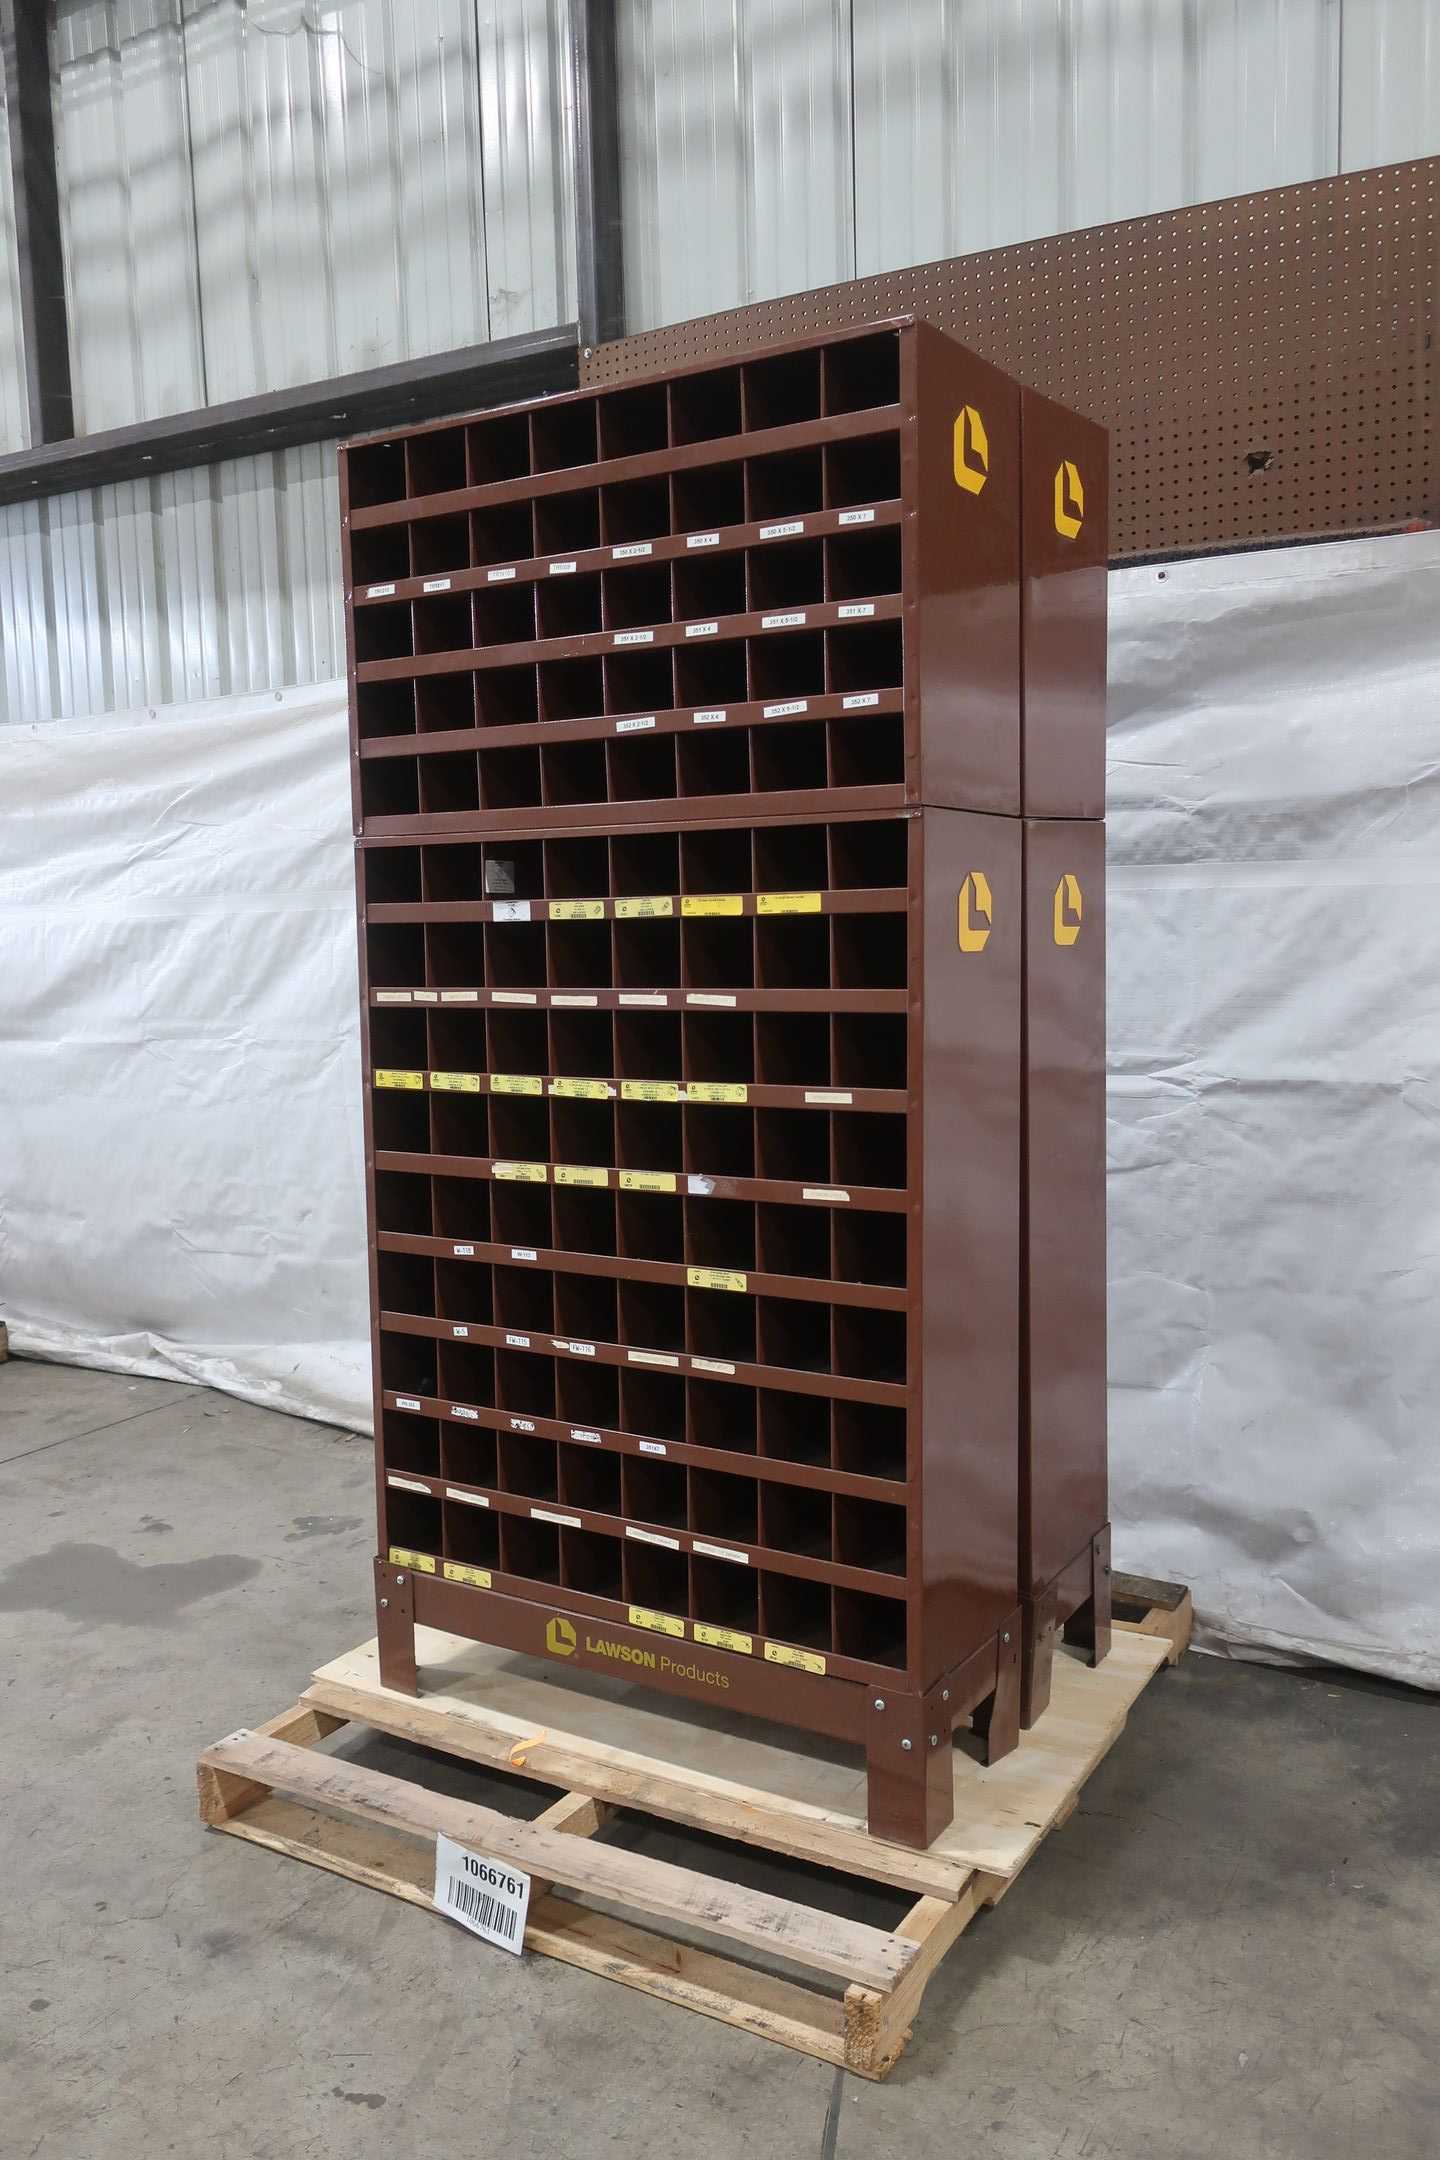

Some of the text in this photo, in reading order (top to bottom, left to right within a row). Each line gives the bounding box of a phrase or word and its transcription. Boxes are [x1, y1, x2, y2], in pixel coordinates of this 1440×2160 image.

[586, 1636, 656, 1669] LAWSON
[661, 1656, 730, 1689] Products
[462, 1856, 524, 1899] 1066761
